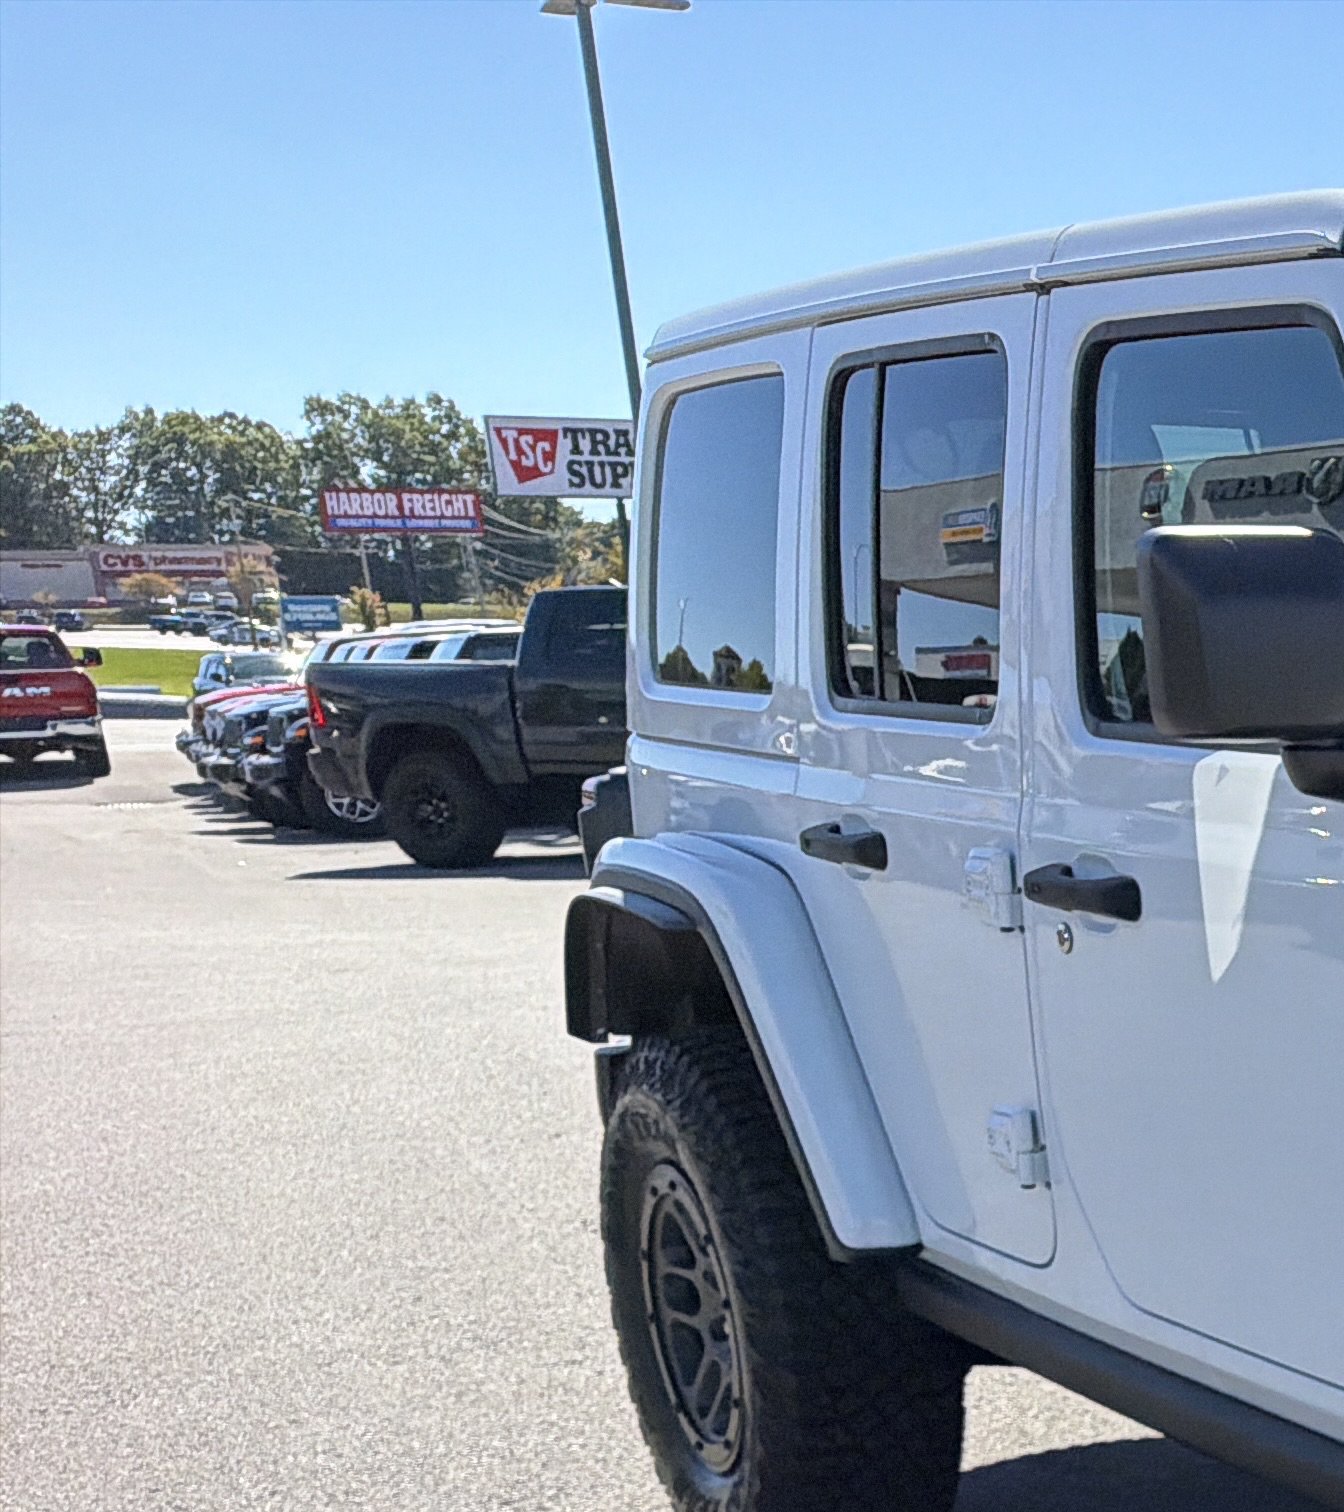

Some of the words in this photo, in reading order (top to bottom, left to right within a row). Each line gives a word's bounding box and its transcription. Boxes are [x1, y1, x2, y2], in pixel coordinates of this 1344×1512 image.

[501, 428, 553, 474] TSC
[566, 459, 635, 489] SUP
[324, 491, 400, 516] HARBOR
[401, 492, 476, 517] FREIGHT
[102, 553, 146, 568] CVS
